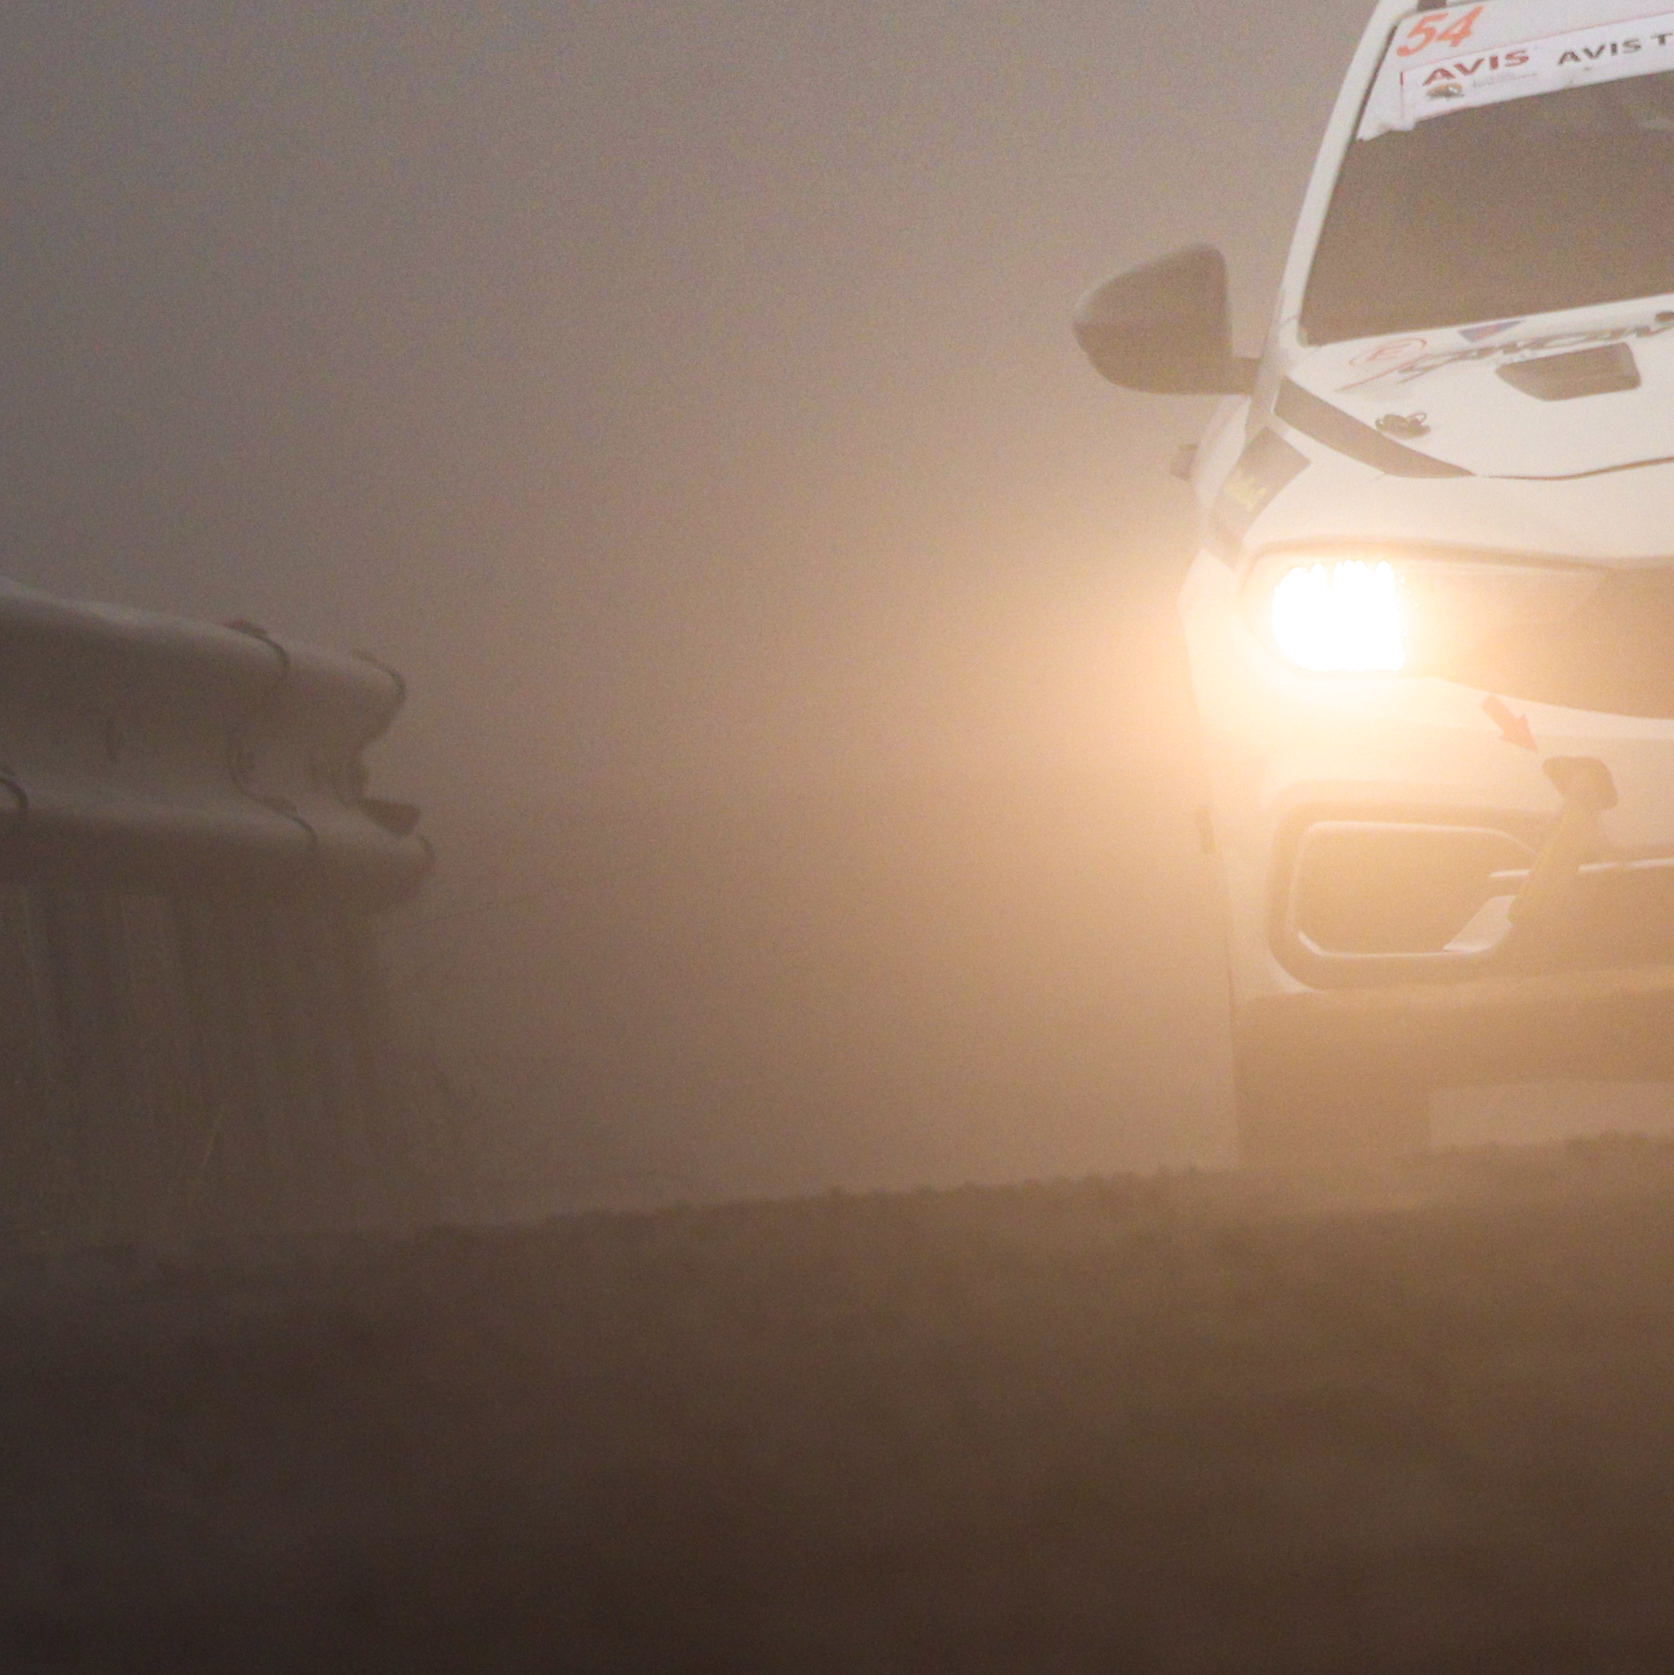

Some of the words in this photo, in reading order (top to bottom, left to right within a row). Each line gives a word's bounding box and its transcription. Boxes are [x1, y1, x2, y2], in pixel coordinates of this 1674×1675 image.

[1396, 5, 1484, 57] 54
[1422, 49, 1531, 87] AVIS
[1556, 37, 1642, 67] AVIS
